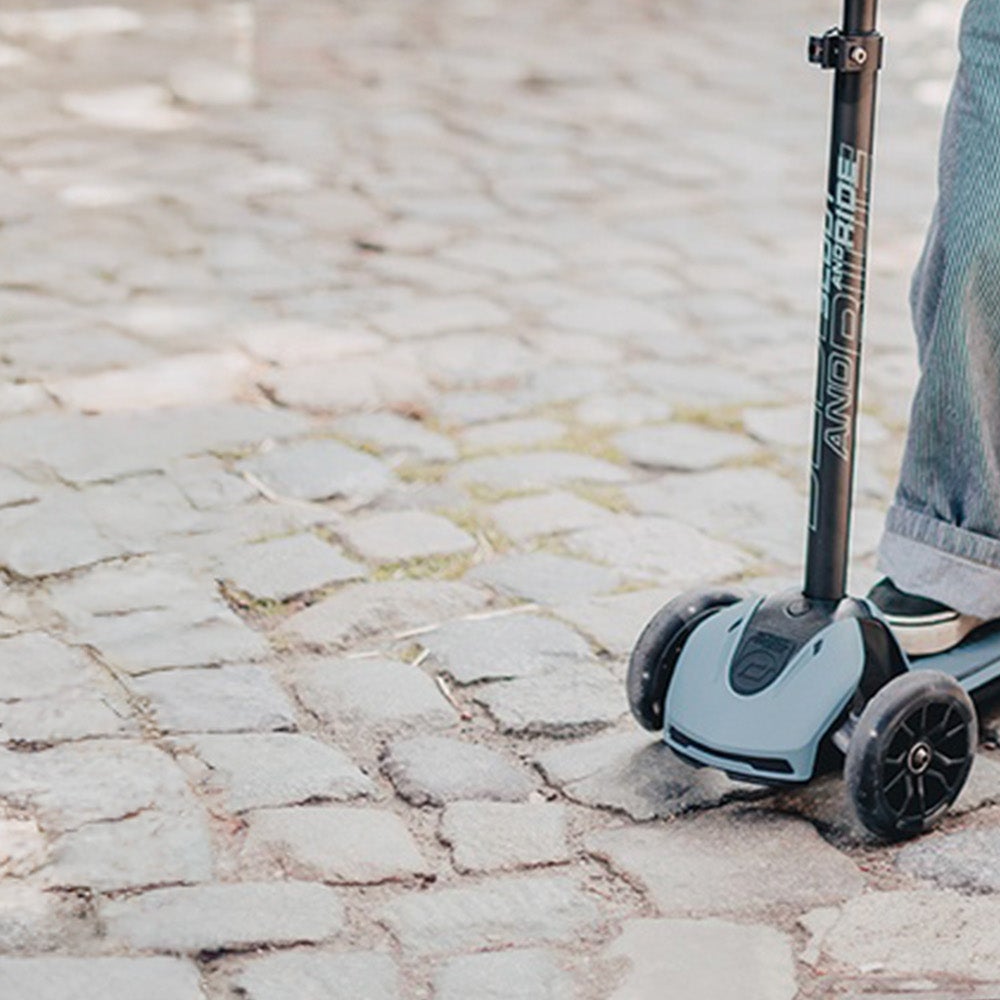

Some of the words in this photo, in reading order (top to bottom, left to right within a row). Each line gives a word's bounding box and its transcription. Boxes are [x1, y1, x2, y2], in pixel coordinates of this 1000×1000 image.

[834, 156, 858, 248] RIDE
[831, 246, 846, 290] AND
[823, 351, 853, 461] AND
